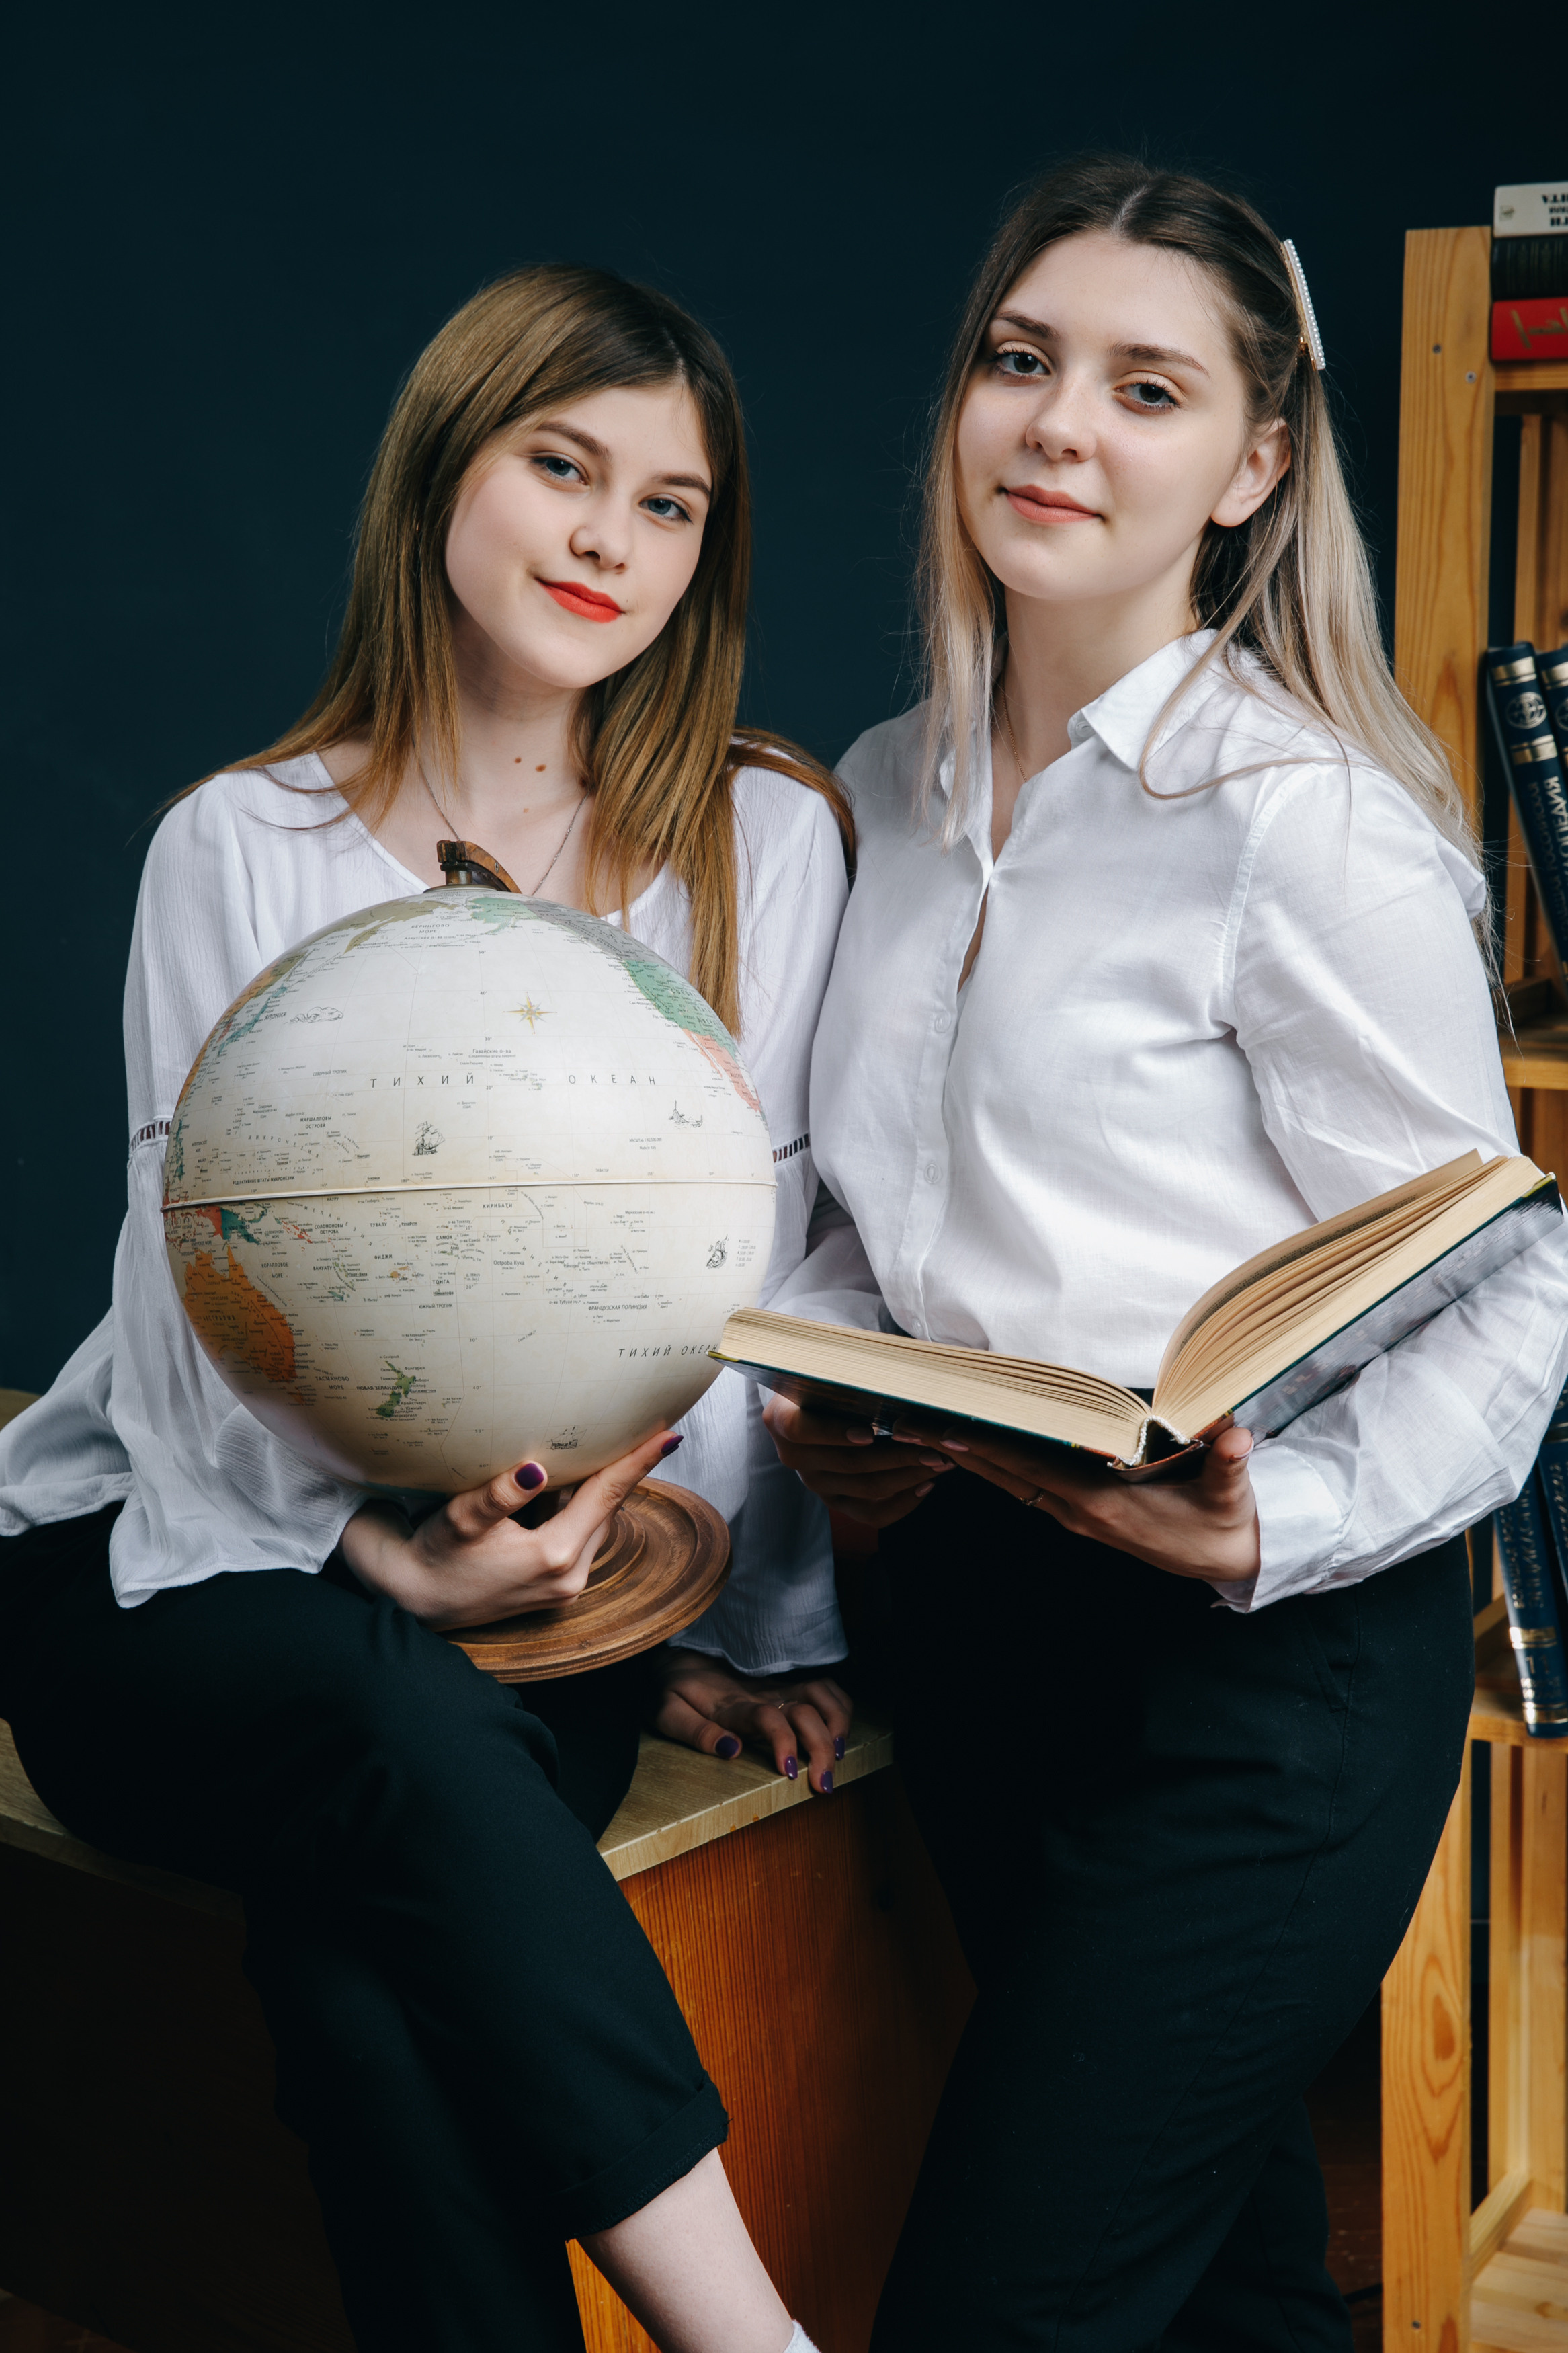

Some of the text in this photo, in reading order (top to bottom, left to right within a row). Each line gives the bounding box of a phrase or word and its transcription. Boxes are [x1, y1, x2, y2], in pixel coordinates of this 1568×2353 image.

[264, 1012, 287, 1021] ЯПОНИЯ
[370, 1072, 656, 1089] ТИХИЙ ОКЕАН
[618, 1344, 672, 1359] ТИХИЙ
